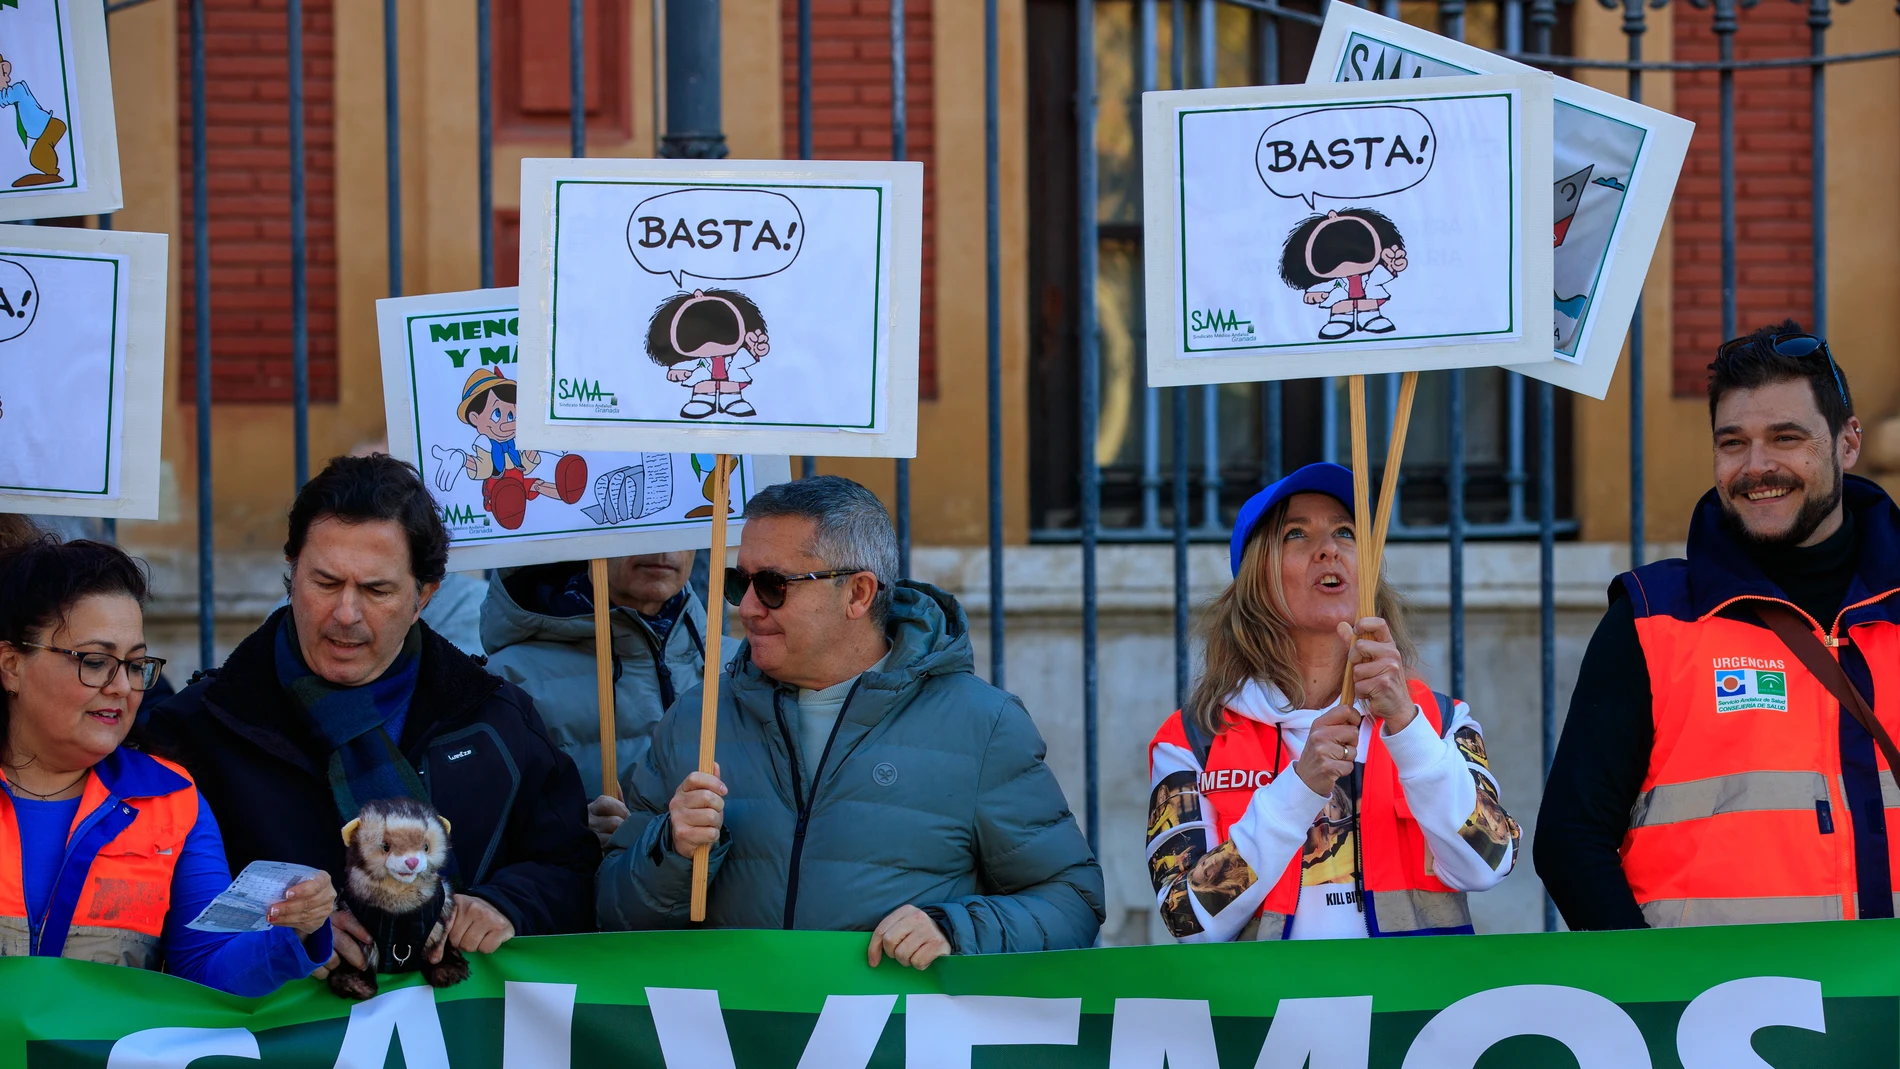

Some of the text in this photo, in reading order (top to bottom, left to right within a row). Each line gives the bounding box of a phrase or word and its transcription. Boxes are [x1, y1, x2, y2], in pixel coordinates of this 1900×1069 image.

[1266, 134, 1429, 172] BASTA!
[638, 216, 798, 252] BASTA!
[1192, 308, 1251, 333] SMA
[444, 348, 471, 368] Y
[559, 377, 614, 402] SMA
[1712, 656, 1785, 669] URGENCIAS
[1326, 892, 1345, 906] KILL
